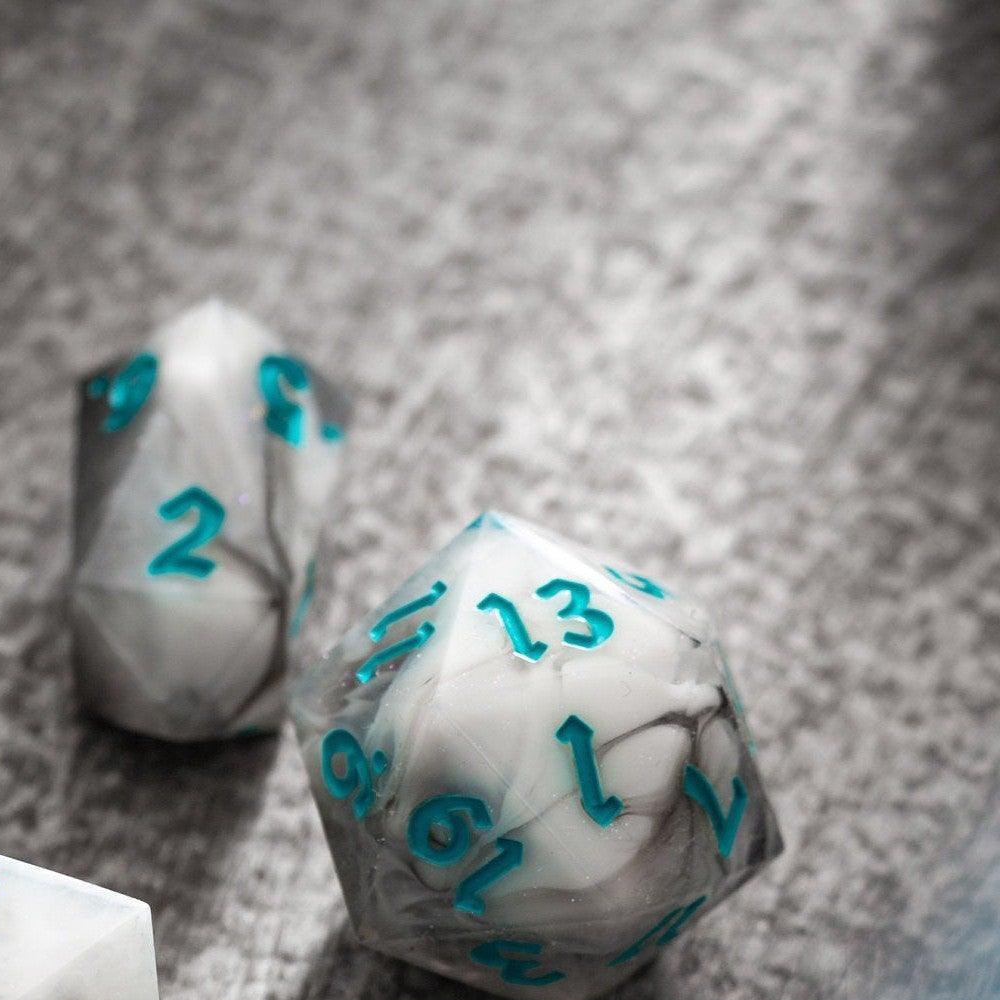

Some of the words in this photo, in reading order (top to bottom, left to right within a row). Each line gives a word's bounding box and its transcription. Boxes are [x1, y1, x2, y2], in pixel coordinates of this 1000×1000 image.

[147, 486, 225, 579] 2
[356, 580, 448, 684] 11
[477, 577, 615, 662] 13
[556, 714, 625, 828] 1
